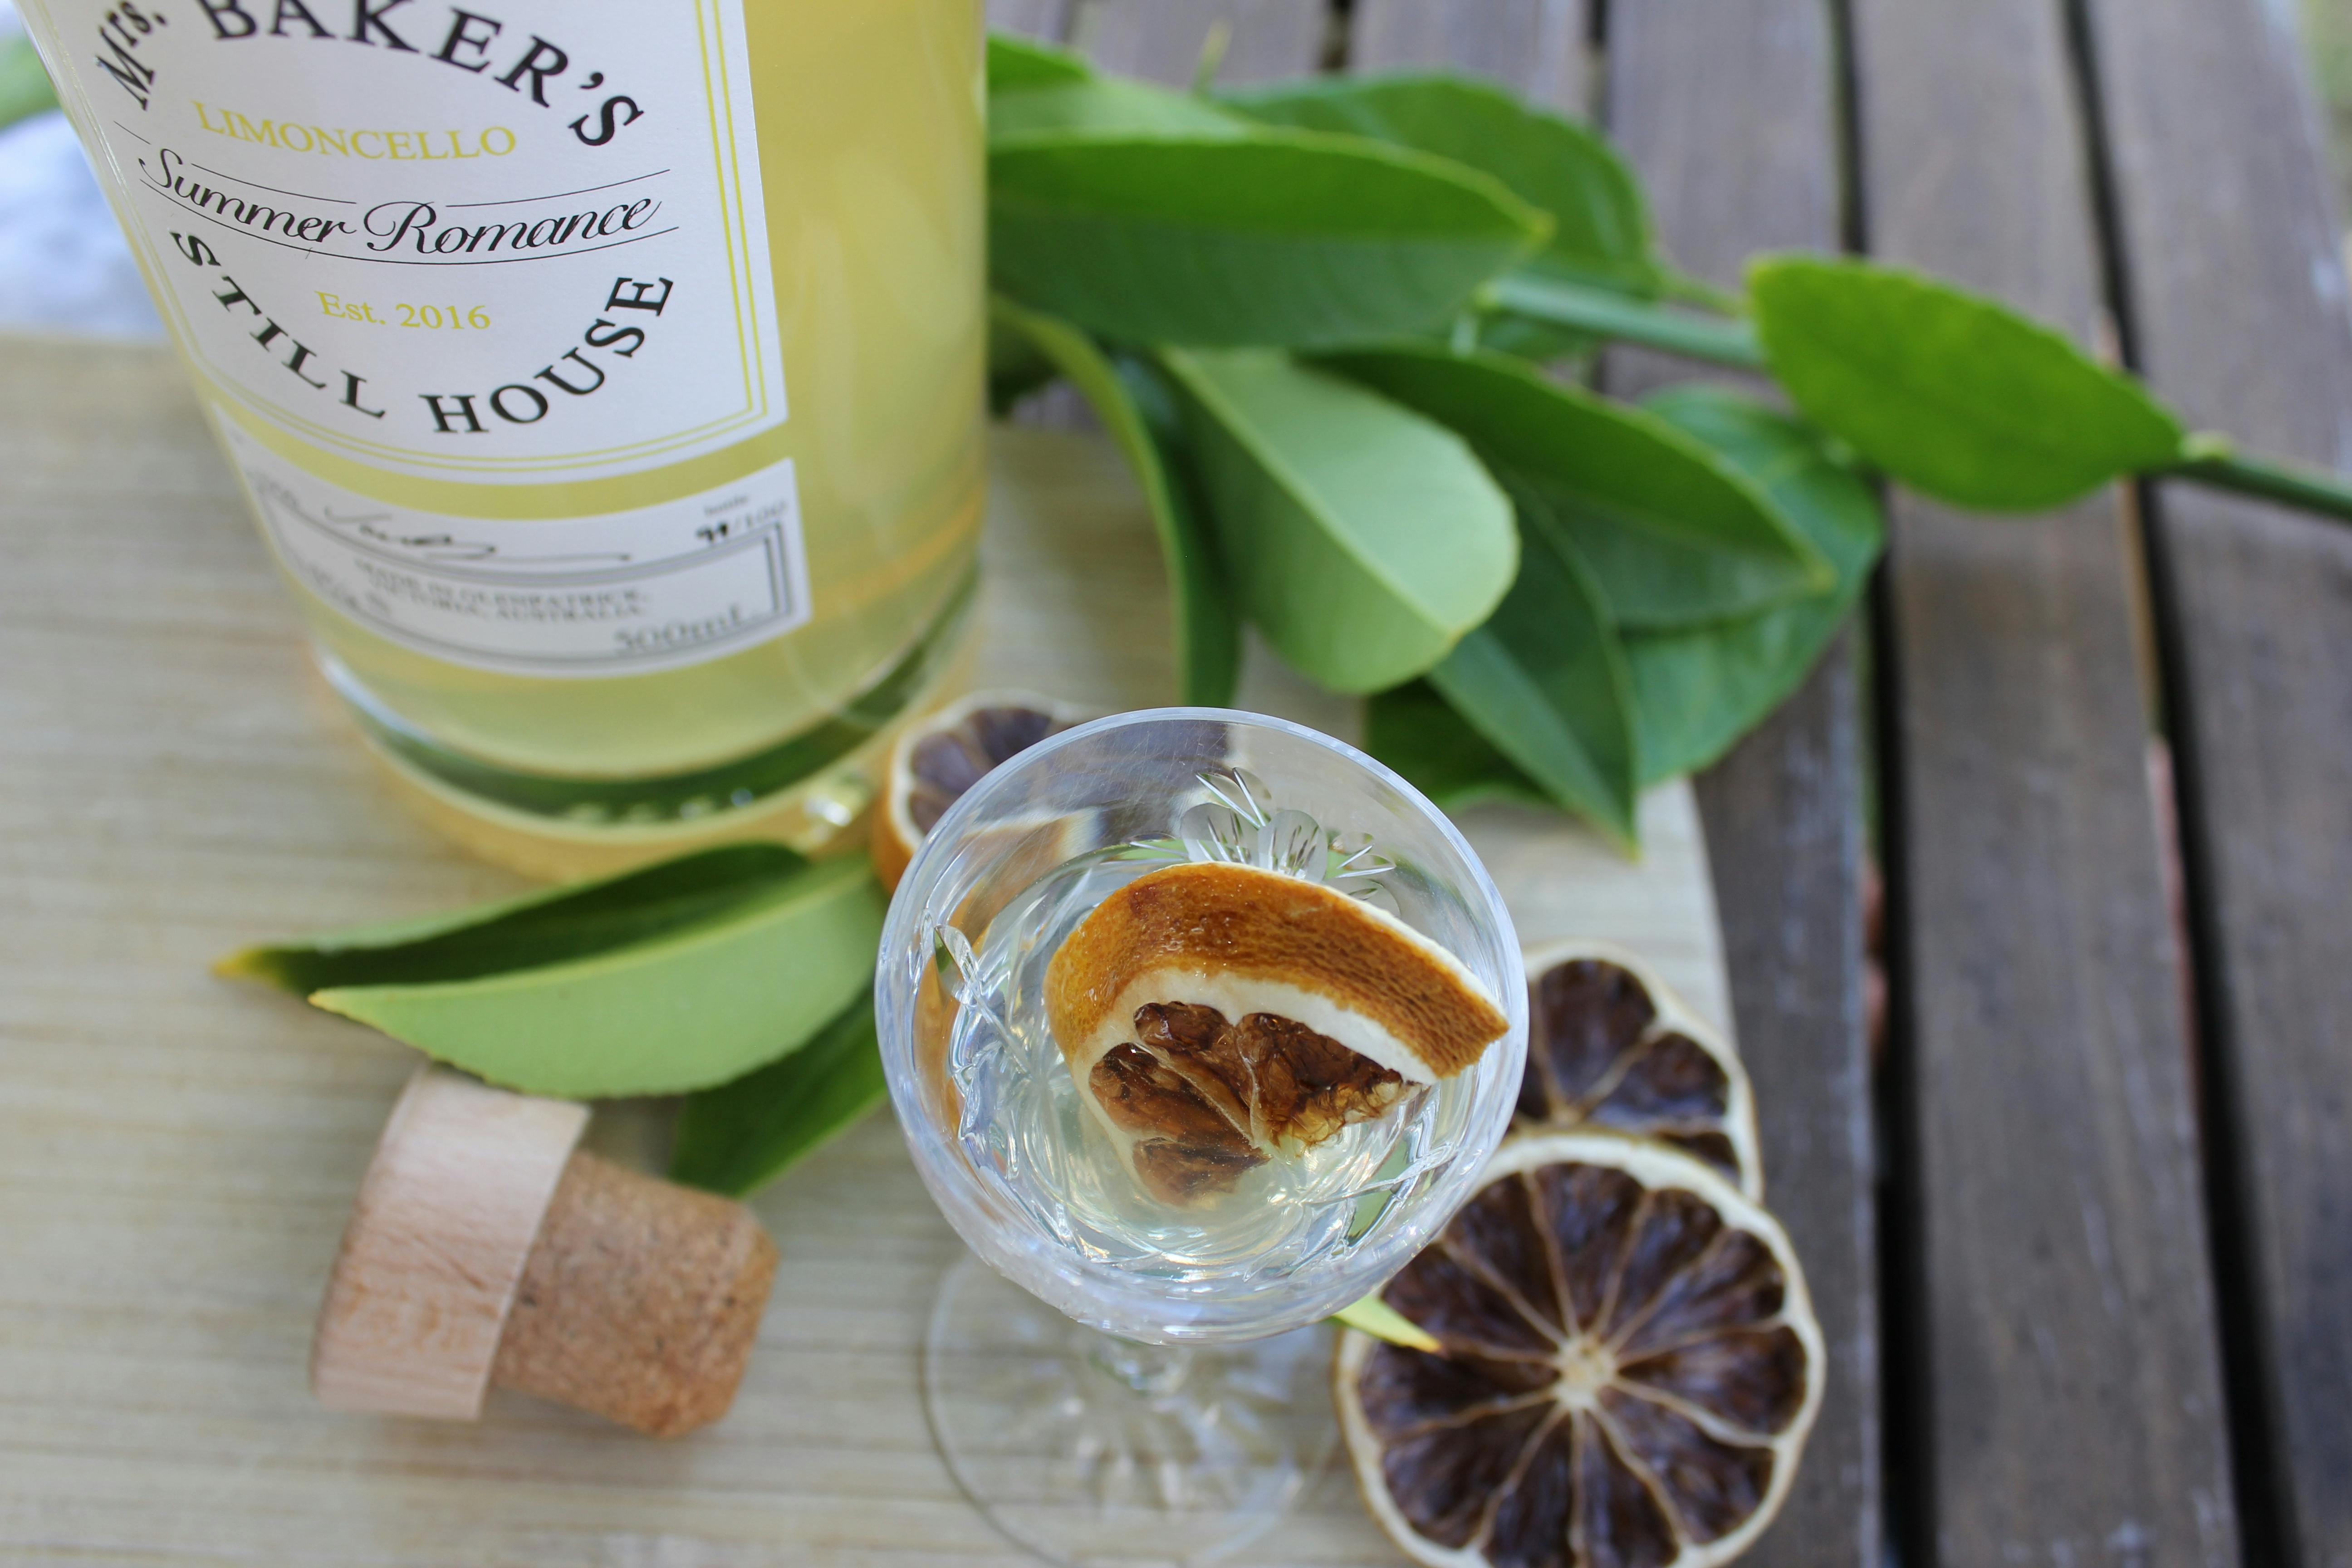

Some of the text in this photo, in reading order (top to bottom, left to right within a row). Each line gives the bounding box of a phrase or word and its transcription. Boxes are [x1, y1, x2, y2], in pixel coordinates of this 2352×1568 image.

[96, 0, 166, 111] Mrs.
[191, 100, 517, 160] LIMONCELLO
[138, 148, 662, 254] Summer Romance
[168, 229, 674, 434] STILL HOUSE
[316, 291, 491, 330] Est. 2016
